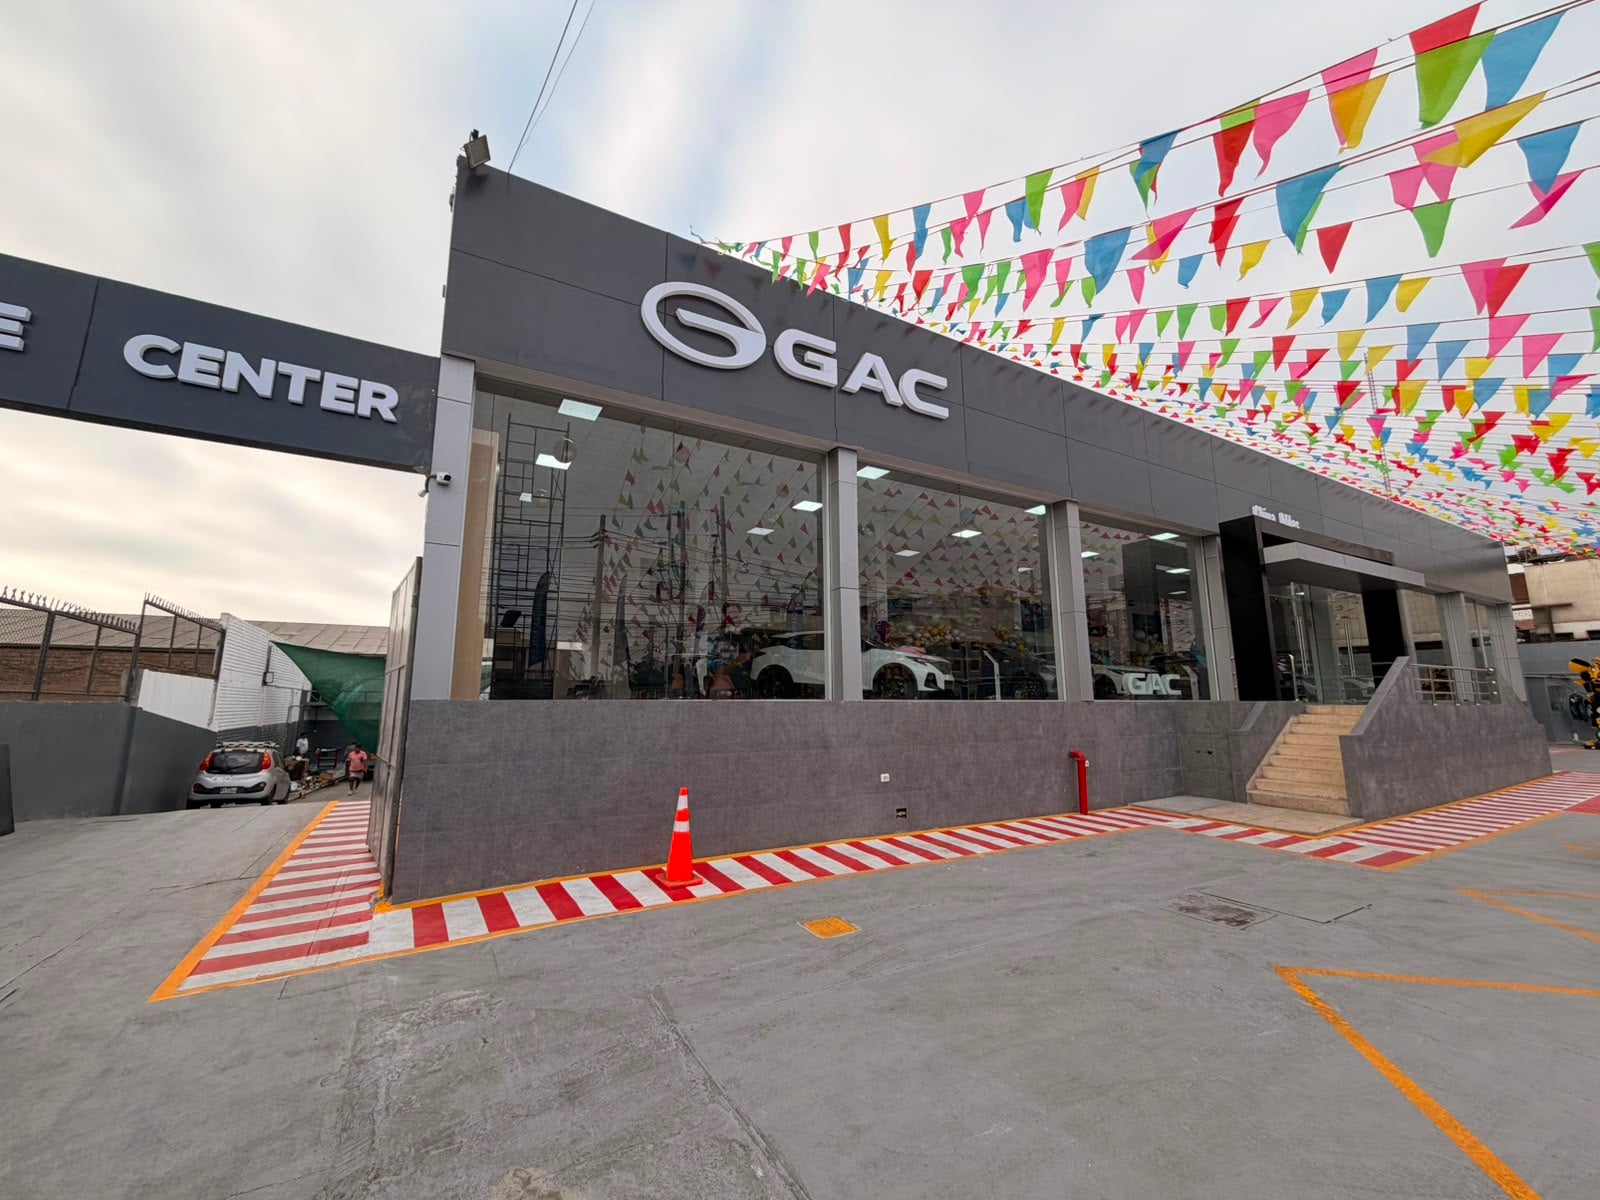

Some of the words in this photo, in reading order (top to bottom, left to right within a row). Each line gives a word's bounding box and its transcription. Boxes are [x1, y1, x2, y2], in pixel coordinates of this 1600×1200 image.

[123, 333, 400, 424] CENTER
[773, 328, 949, 420] GAC
[1123, 672, 1182, 696] GAC
